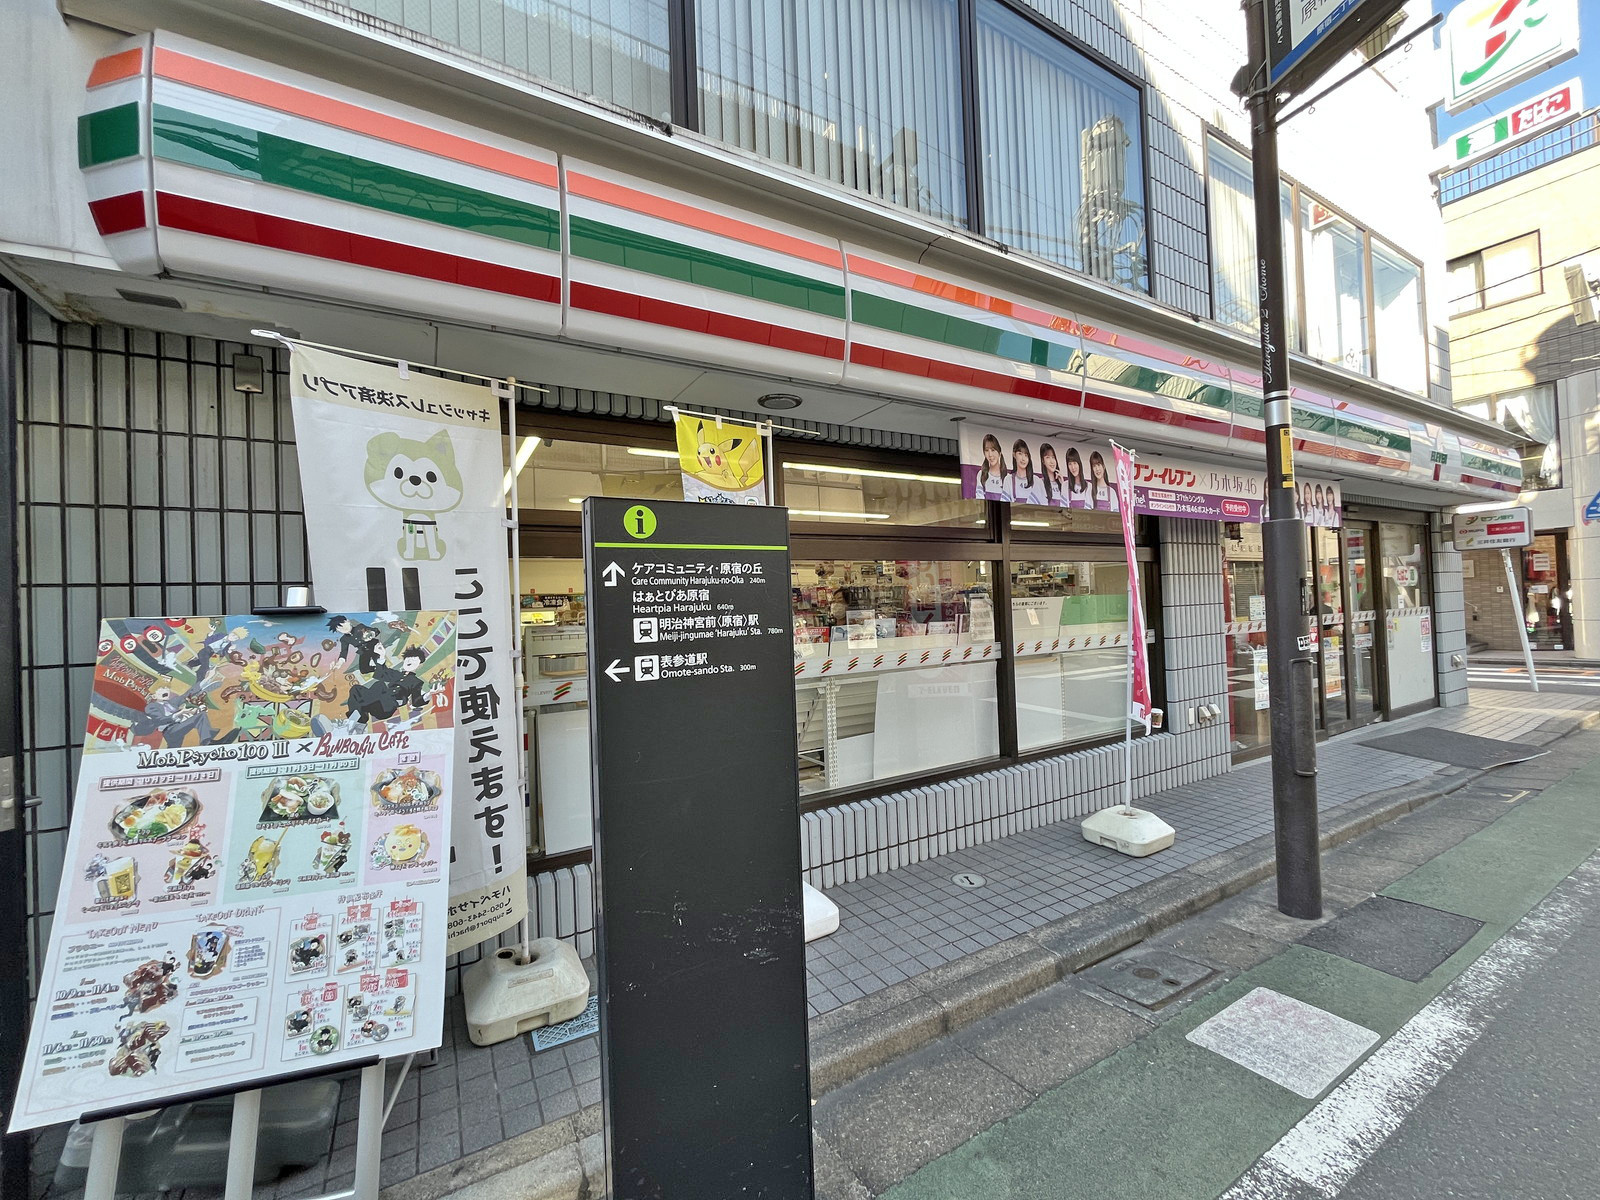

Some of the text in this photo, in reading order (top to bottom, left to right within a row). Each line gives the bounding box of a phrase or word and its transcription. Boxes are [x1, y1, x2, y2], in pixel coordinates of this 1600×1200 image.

[1517, 93, 1566, 132] たばこ
[1260, 308, 1269, 318] 2
[1262, 321, 1276, 384] Harajuku
[1134, 463, 1196, 487] ブン-イレブン
[1210, 473, 1257, 495] 乃木坂46
[1225, 503, 1247, 513] 予約受付中
[632, 562, 763, 574] ケアコミュニティ・原宿の丘
[632, 577, 648, 585] Care
[649, 577, 688, 586] Community
[690, 577, 744, 586] Harajuku-no-Oka
[633, 605, 672, 614] Heartpia
[673, 603, 711, 613] Harajuku
[659, 630, 714, 642] Meiji-jingumae
[750, 627, 763, 635] Sta.
[660, 652, 709, 668] 表参道駅
[660, 667, 719, 679] Omote-sando
[720, 665, 735, 673] Sta.
